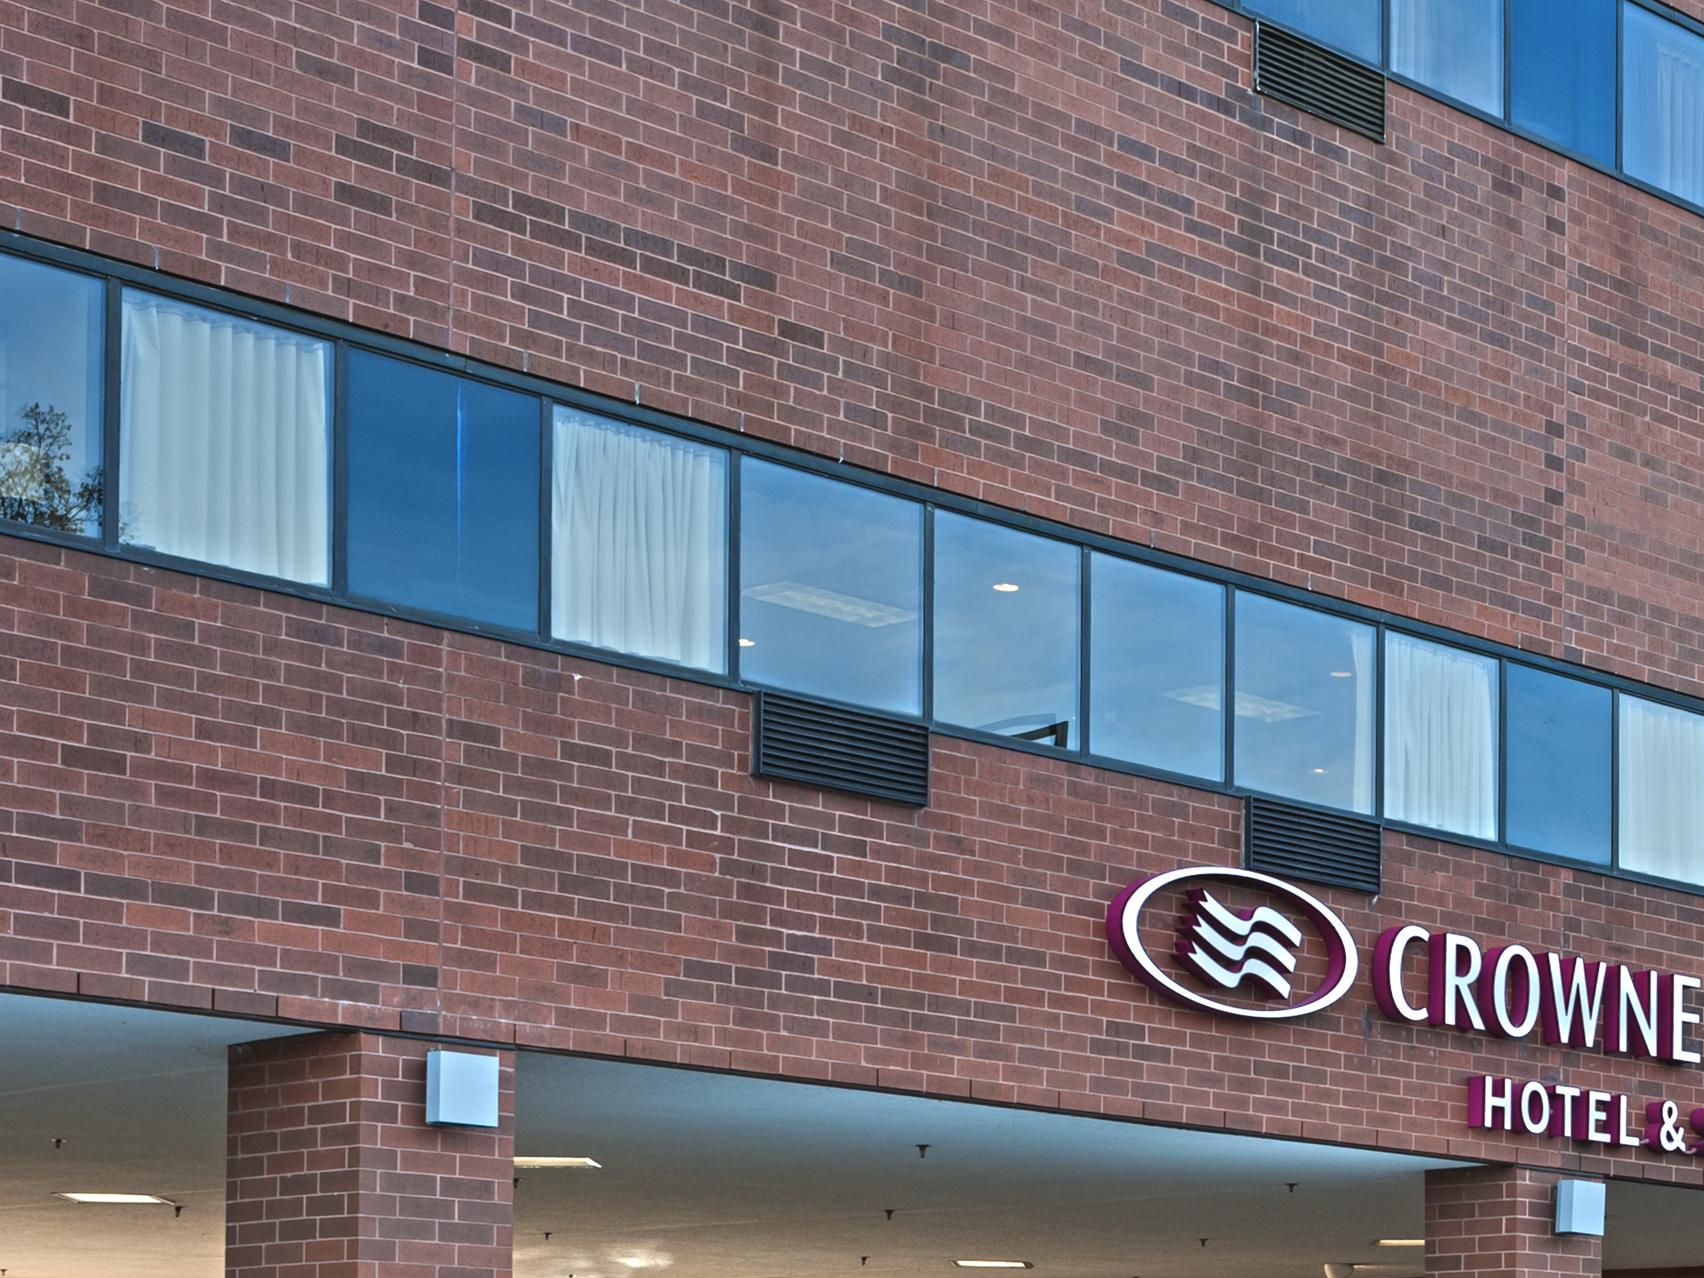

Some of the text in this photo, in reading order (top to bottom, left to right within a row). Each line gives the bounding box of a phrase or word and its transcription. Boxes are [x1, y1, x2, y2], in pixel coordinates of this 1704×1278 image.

[1387, 924, 1702, 1064] CROWNE
[1482, 1074, 1642, 1148] HOTEL
[1658, 1099, 1687, 1153] &
